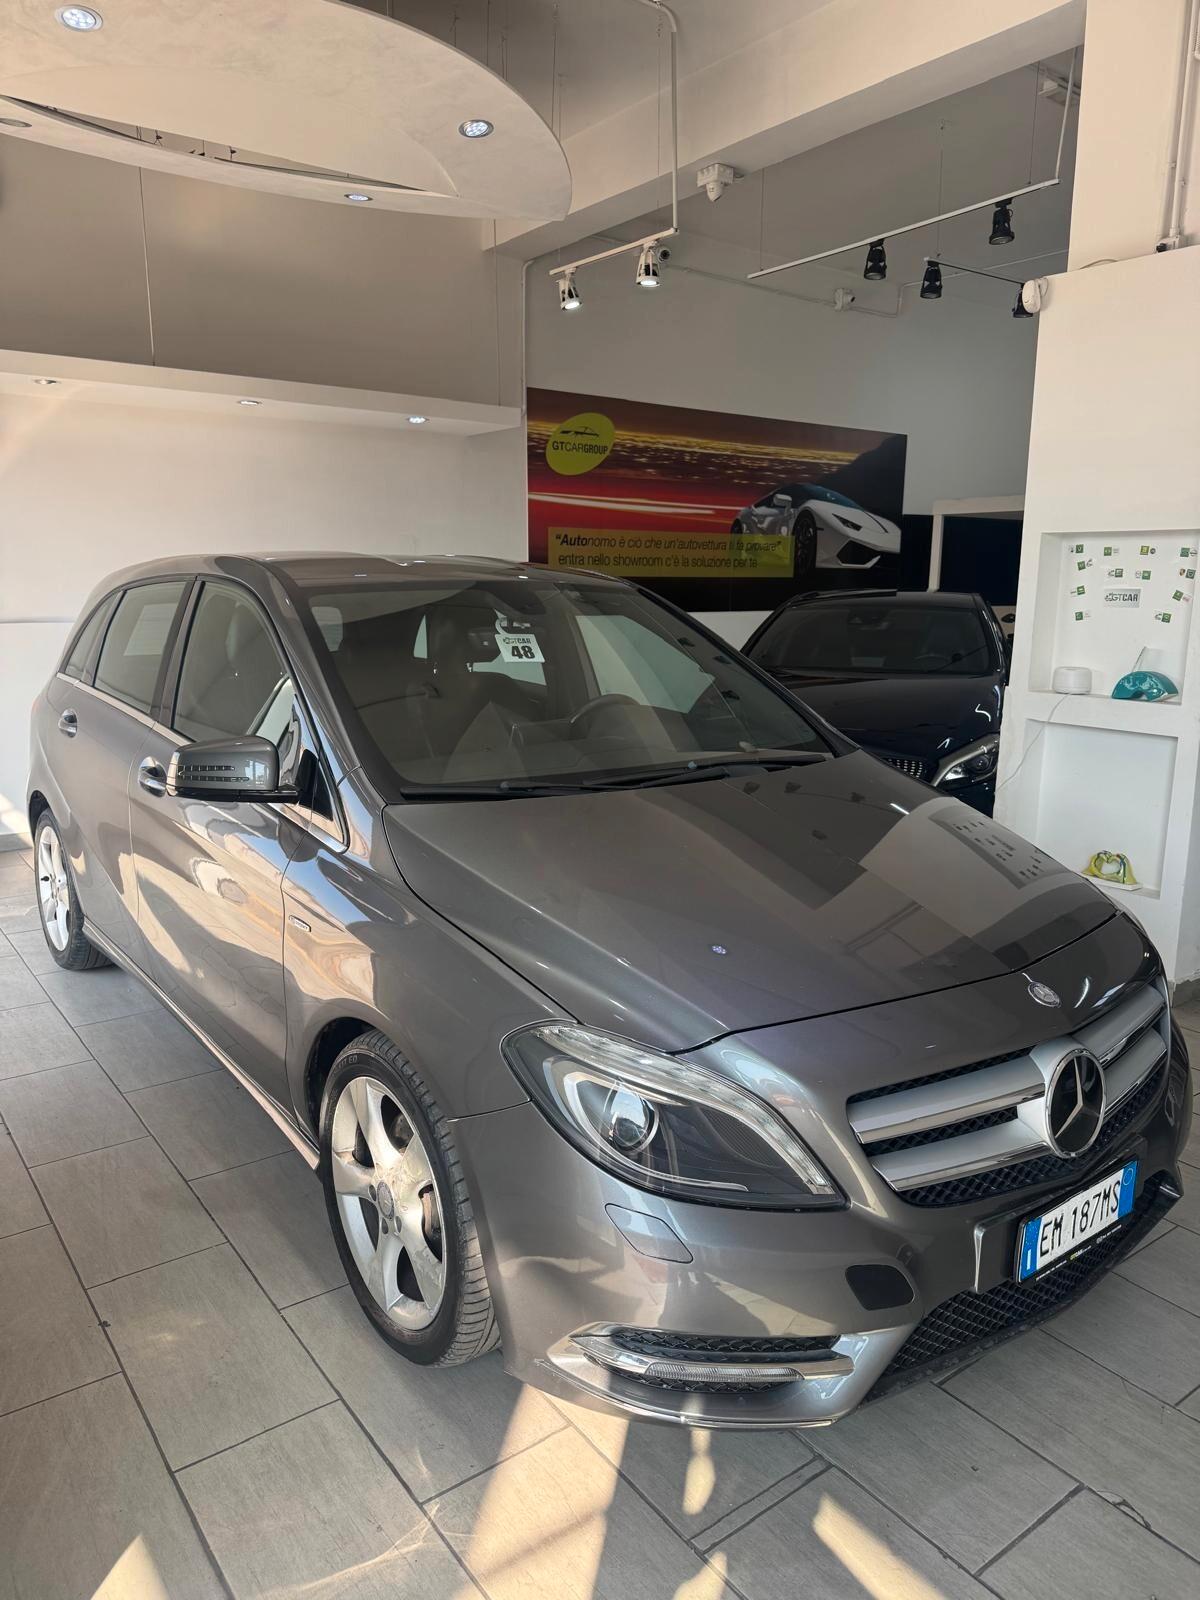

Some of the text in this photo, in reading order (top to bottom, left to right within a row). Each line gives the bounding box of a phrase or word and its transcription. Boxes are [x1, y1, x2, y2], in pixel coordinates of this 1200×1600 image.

[552, 441, 608, 455] GTCARGROUP
[619, 536, 625, 548] è
[644, 537, 662, 549] che
[558, 553, 584, 566] entra
[587, 553, 610, 566] nello
[613, 553, 663, 567] showroom
[682, 555, 689, 567] la
[691, 556, 731, 568] soluzione
[733, 558, 747, 570] per
[749, 558, 758, 568] te
[511, 646, 536, 659] 48
[1039, 1180, 1121, 1257] EM 187MS
